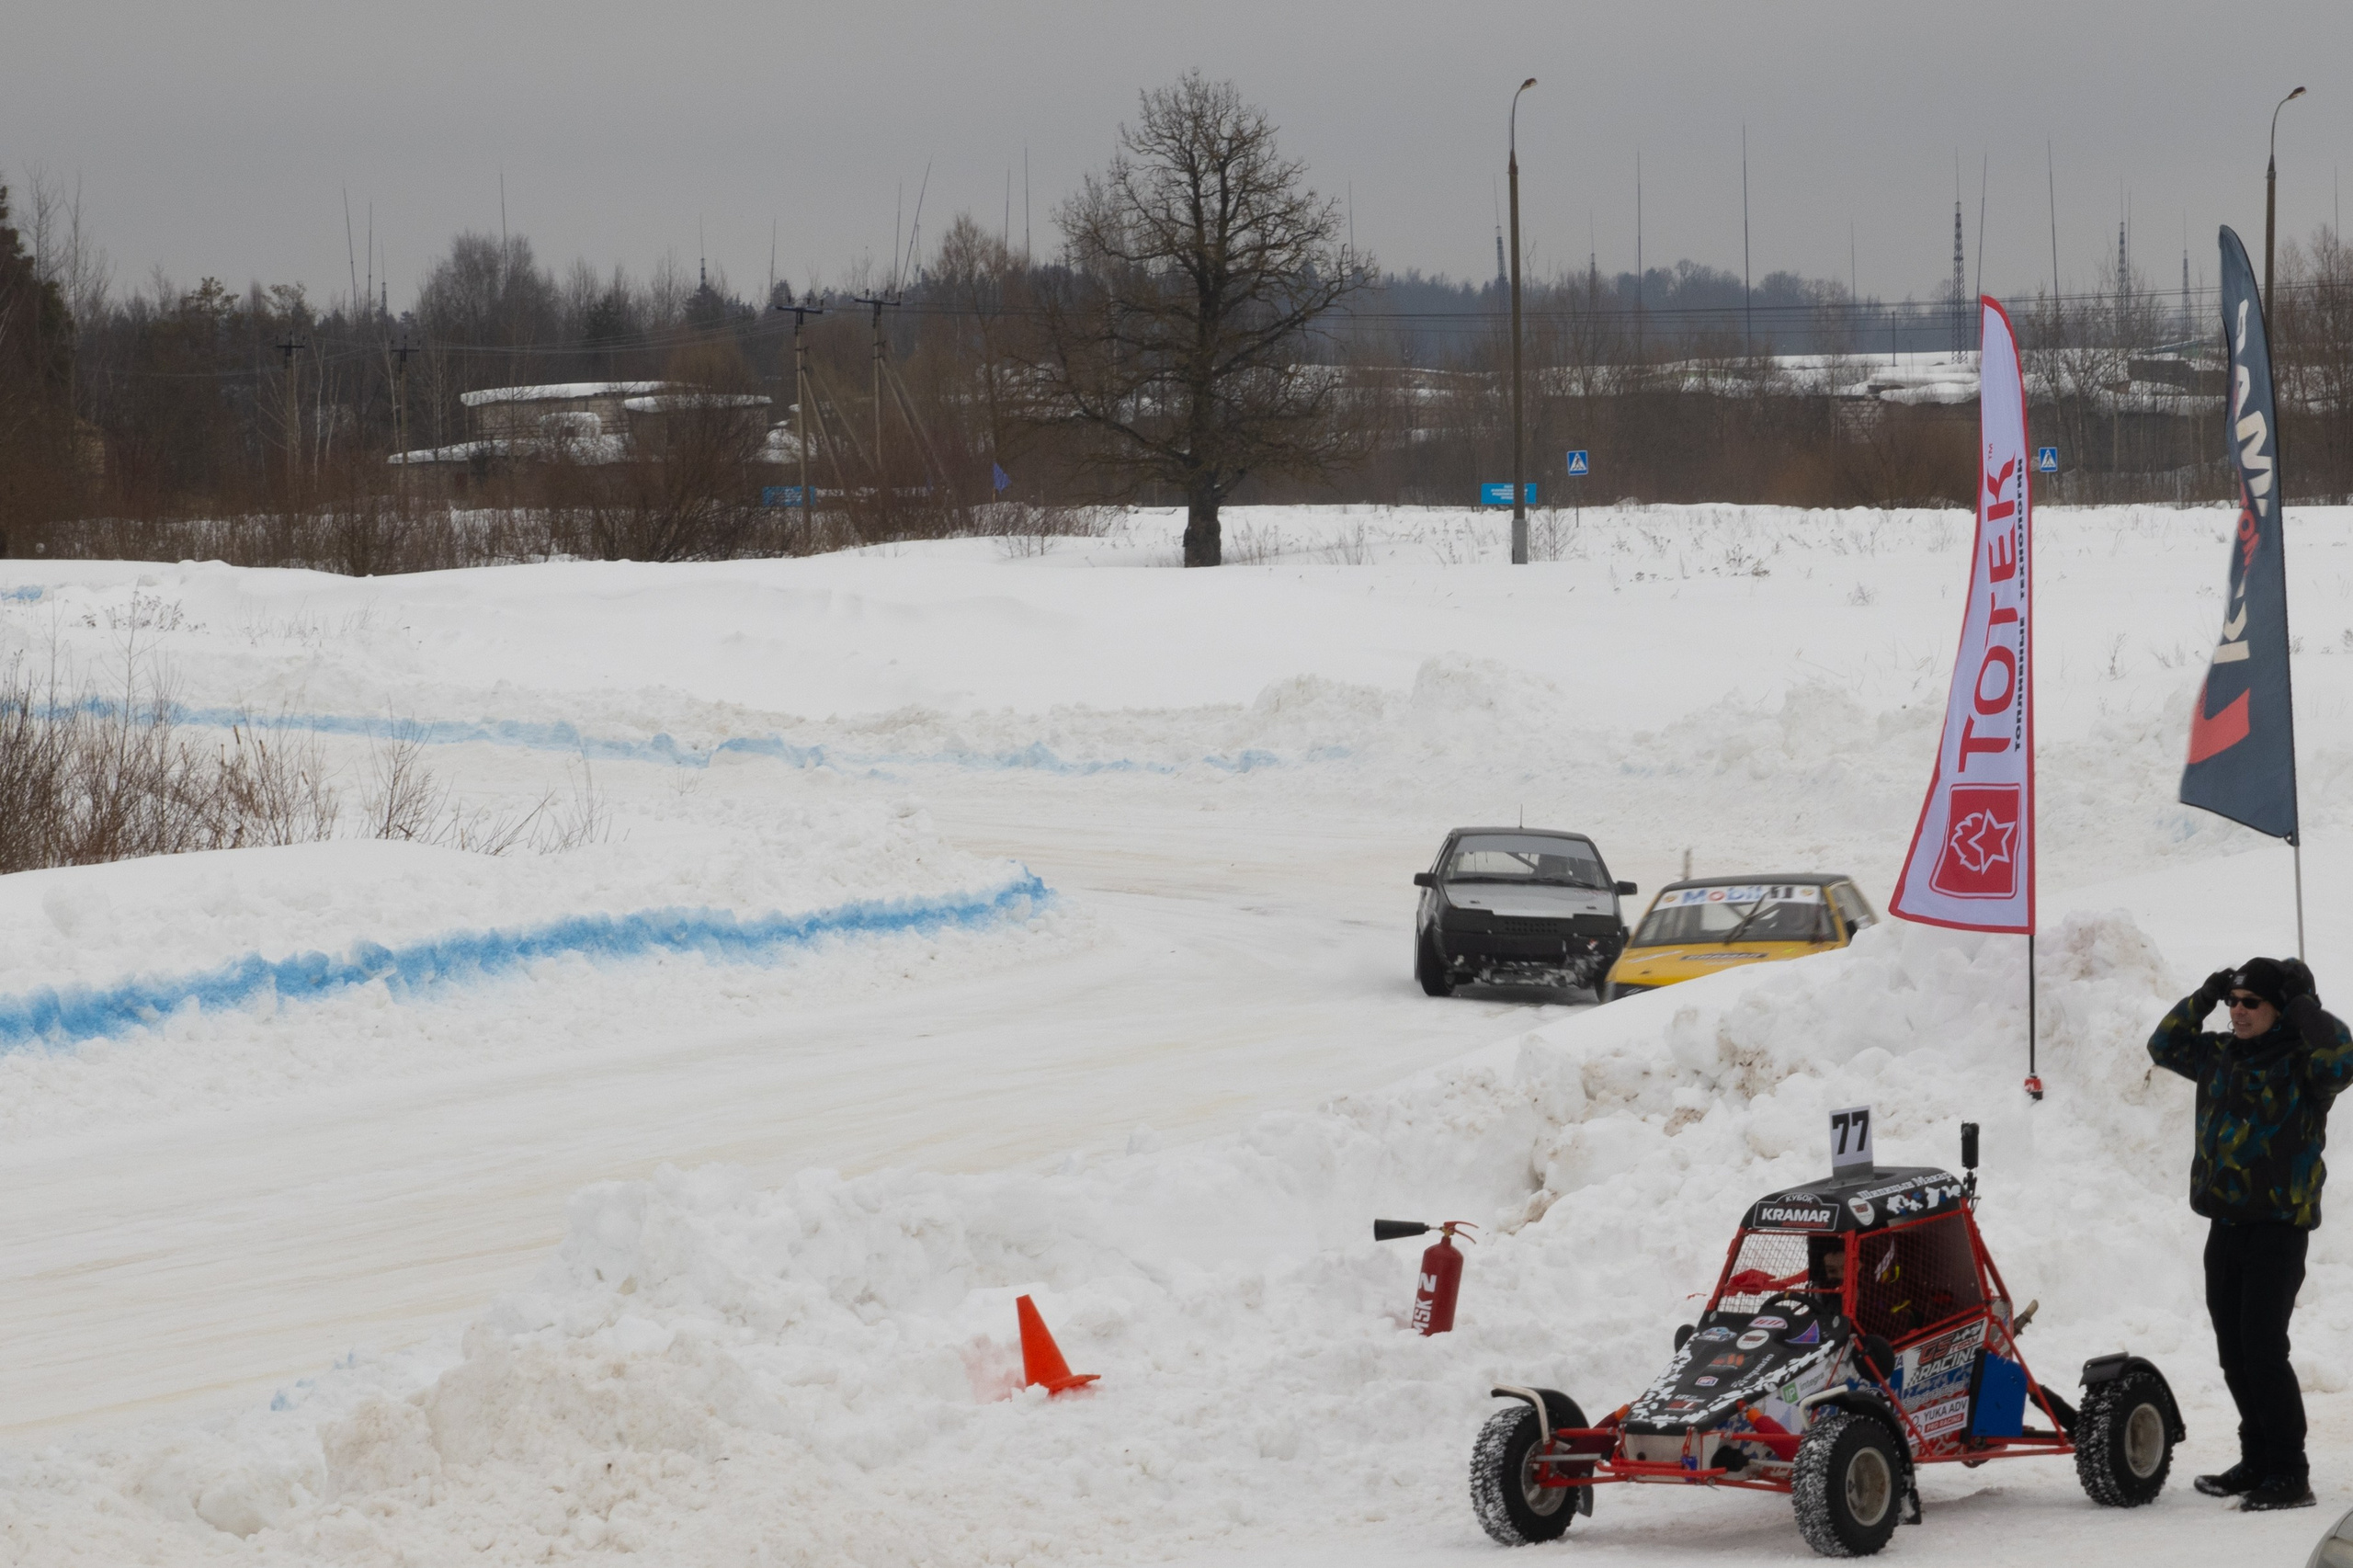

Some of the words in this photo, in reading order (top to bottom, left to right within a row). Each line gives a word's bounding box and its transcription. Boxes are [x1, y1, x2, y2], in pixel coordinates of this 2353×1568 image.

[2018, 458, 2026, 601] ТЕХНОЛОГИИ
[2015, 616, 2026, 753] ТОПЛИВНЫЕ
[1681, 885, 1762, 904] Mobil
[1832, 1109, 1870, 1155] 77
[1912, 1172, 1952, 1187] Макар
[1785, 1194, 1815, 1203] КУБОК
[1761, 1208, 1831, 1222] KRAMAR
[1918, 1335, 1953, 1365] GS
[1924, 1405, 1948, 1422] YUKA
[1949, 1399, 1968, 1414] ADV
